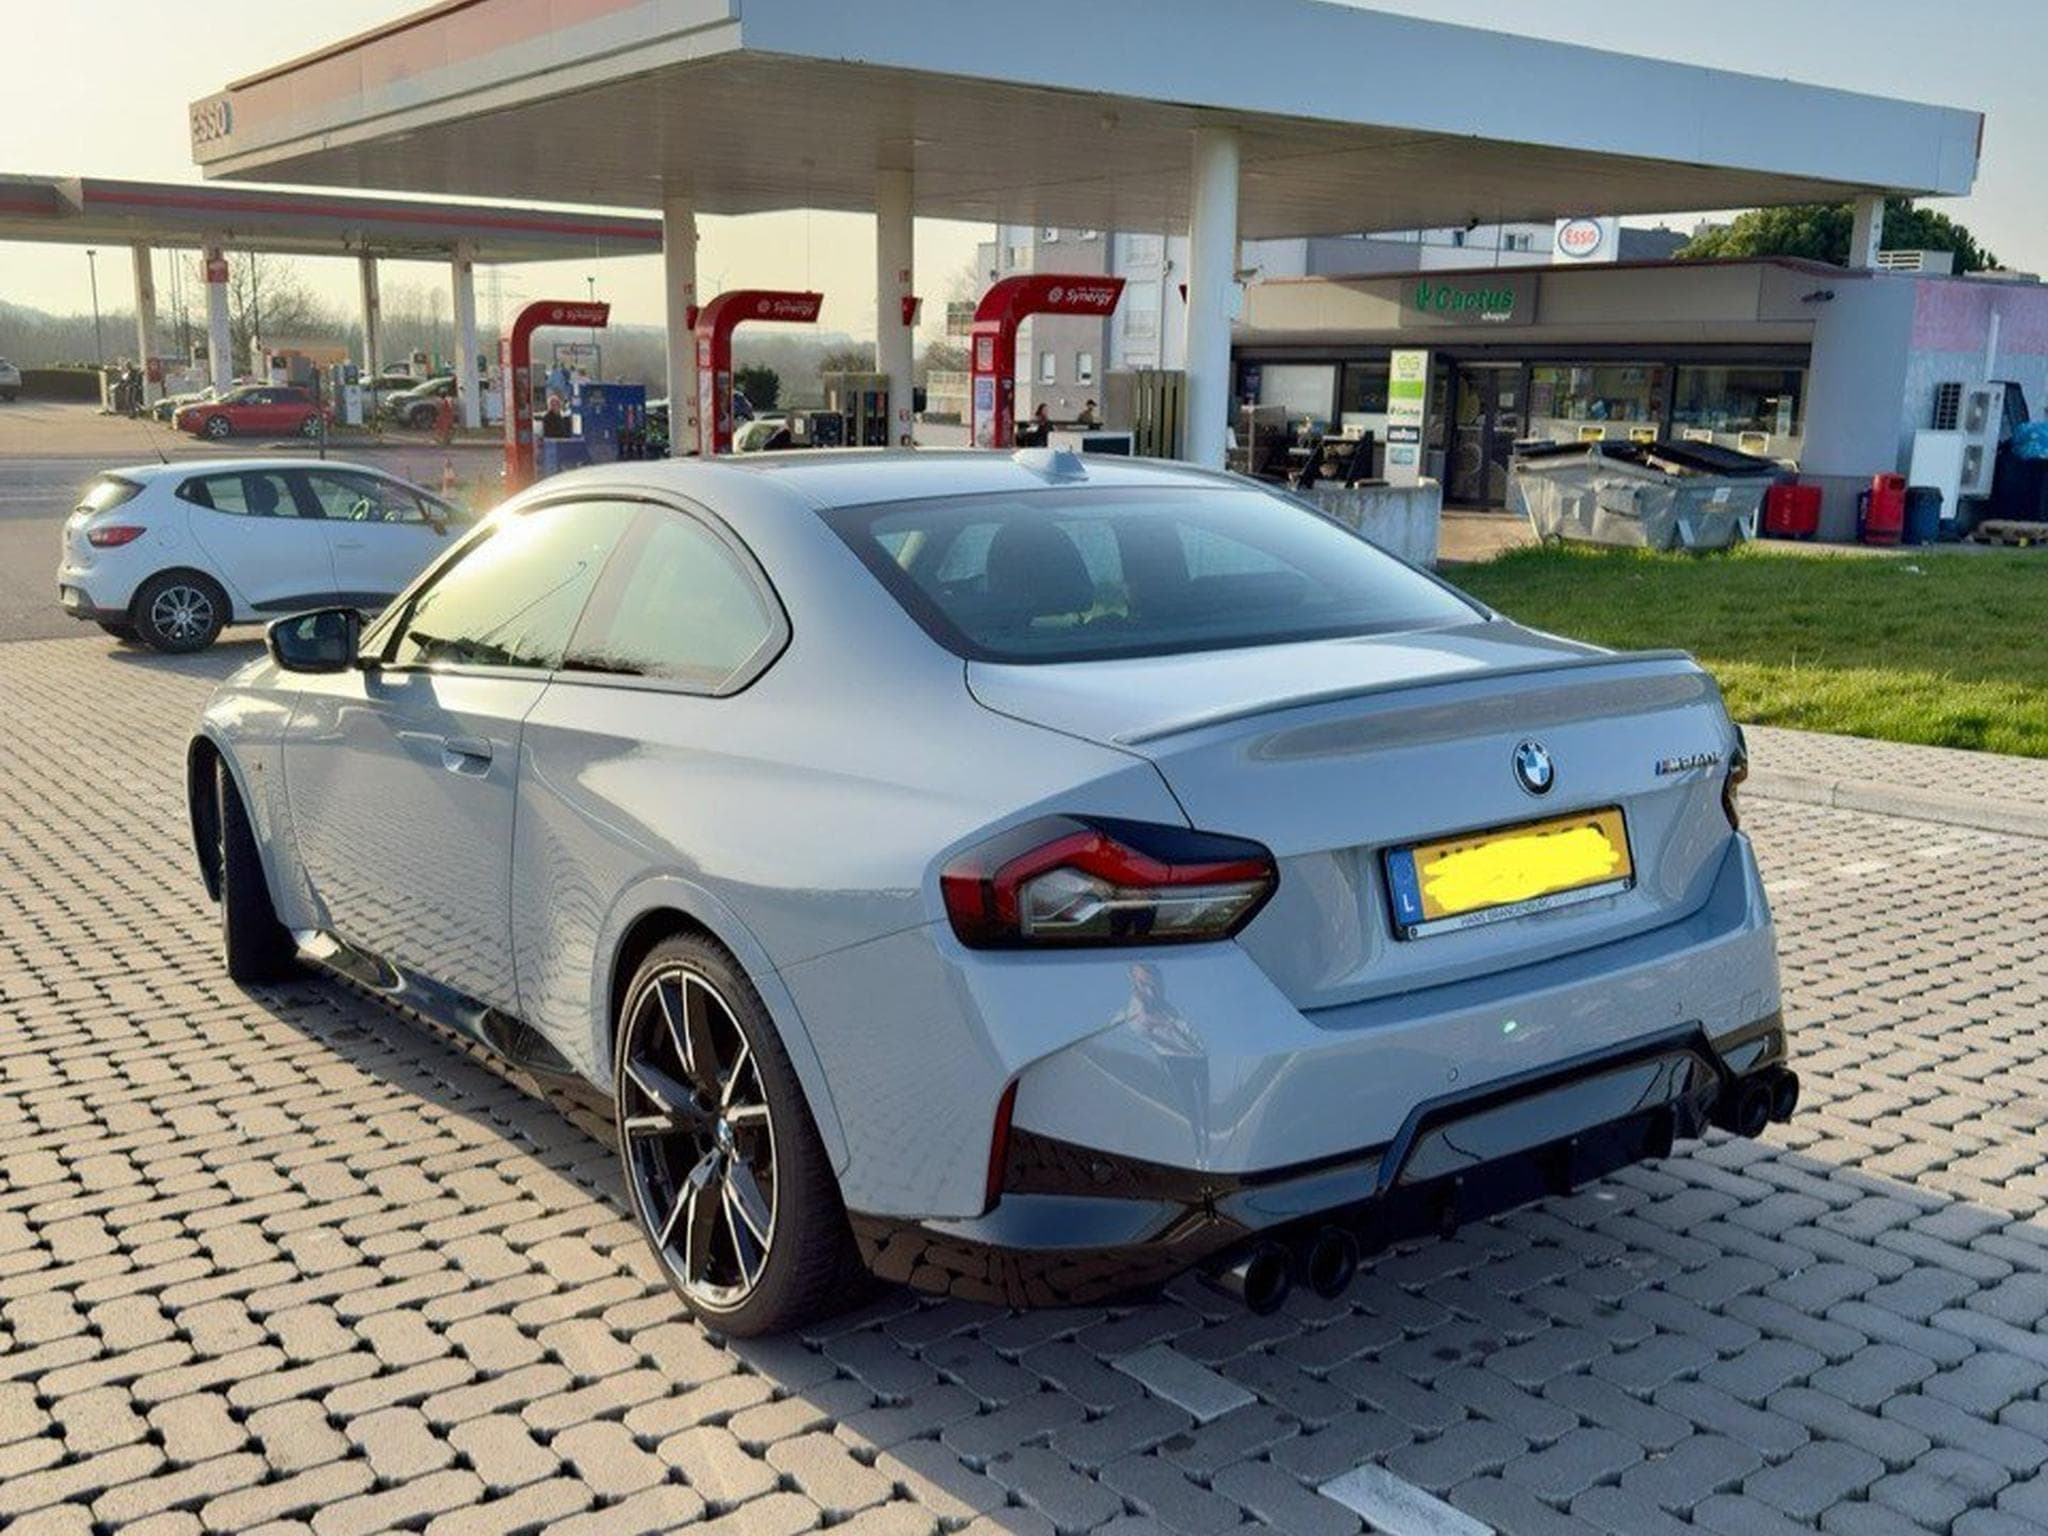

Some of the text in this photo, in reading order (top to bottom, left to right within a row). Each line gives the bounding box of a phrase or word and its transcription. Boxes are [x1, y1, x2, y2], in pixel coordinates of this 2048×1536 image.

[1066, 287, 1114, 306] Synergy
[1436, 285, 1513, 311] Cactus
[1403, 893, 1414, 912] L
